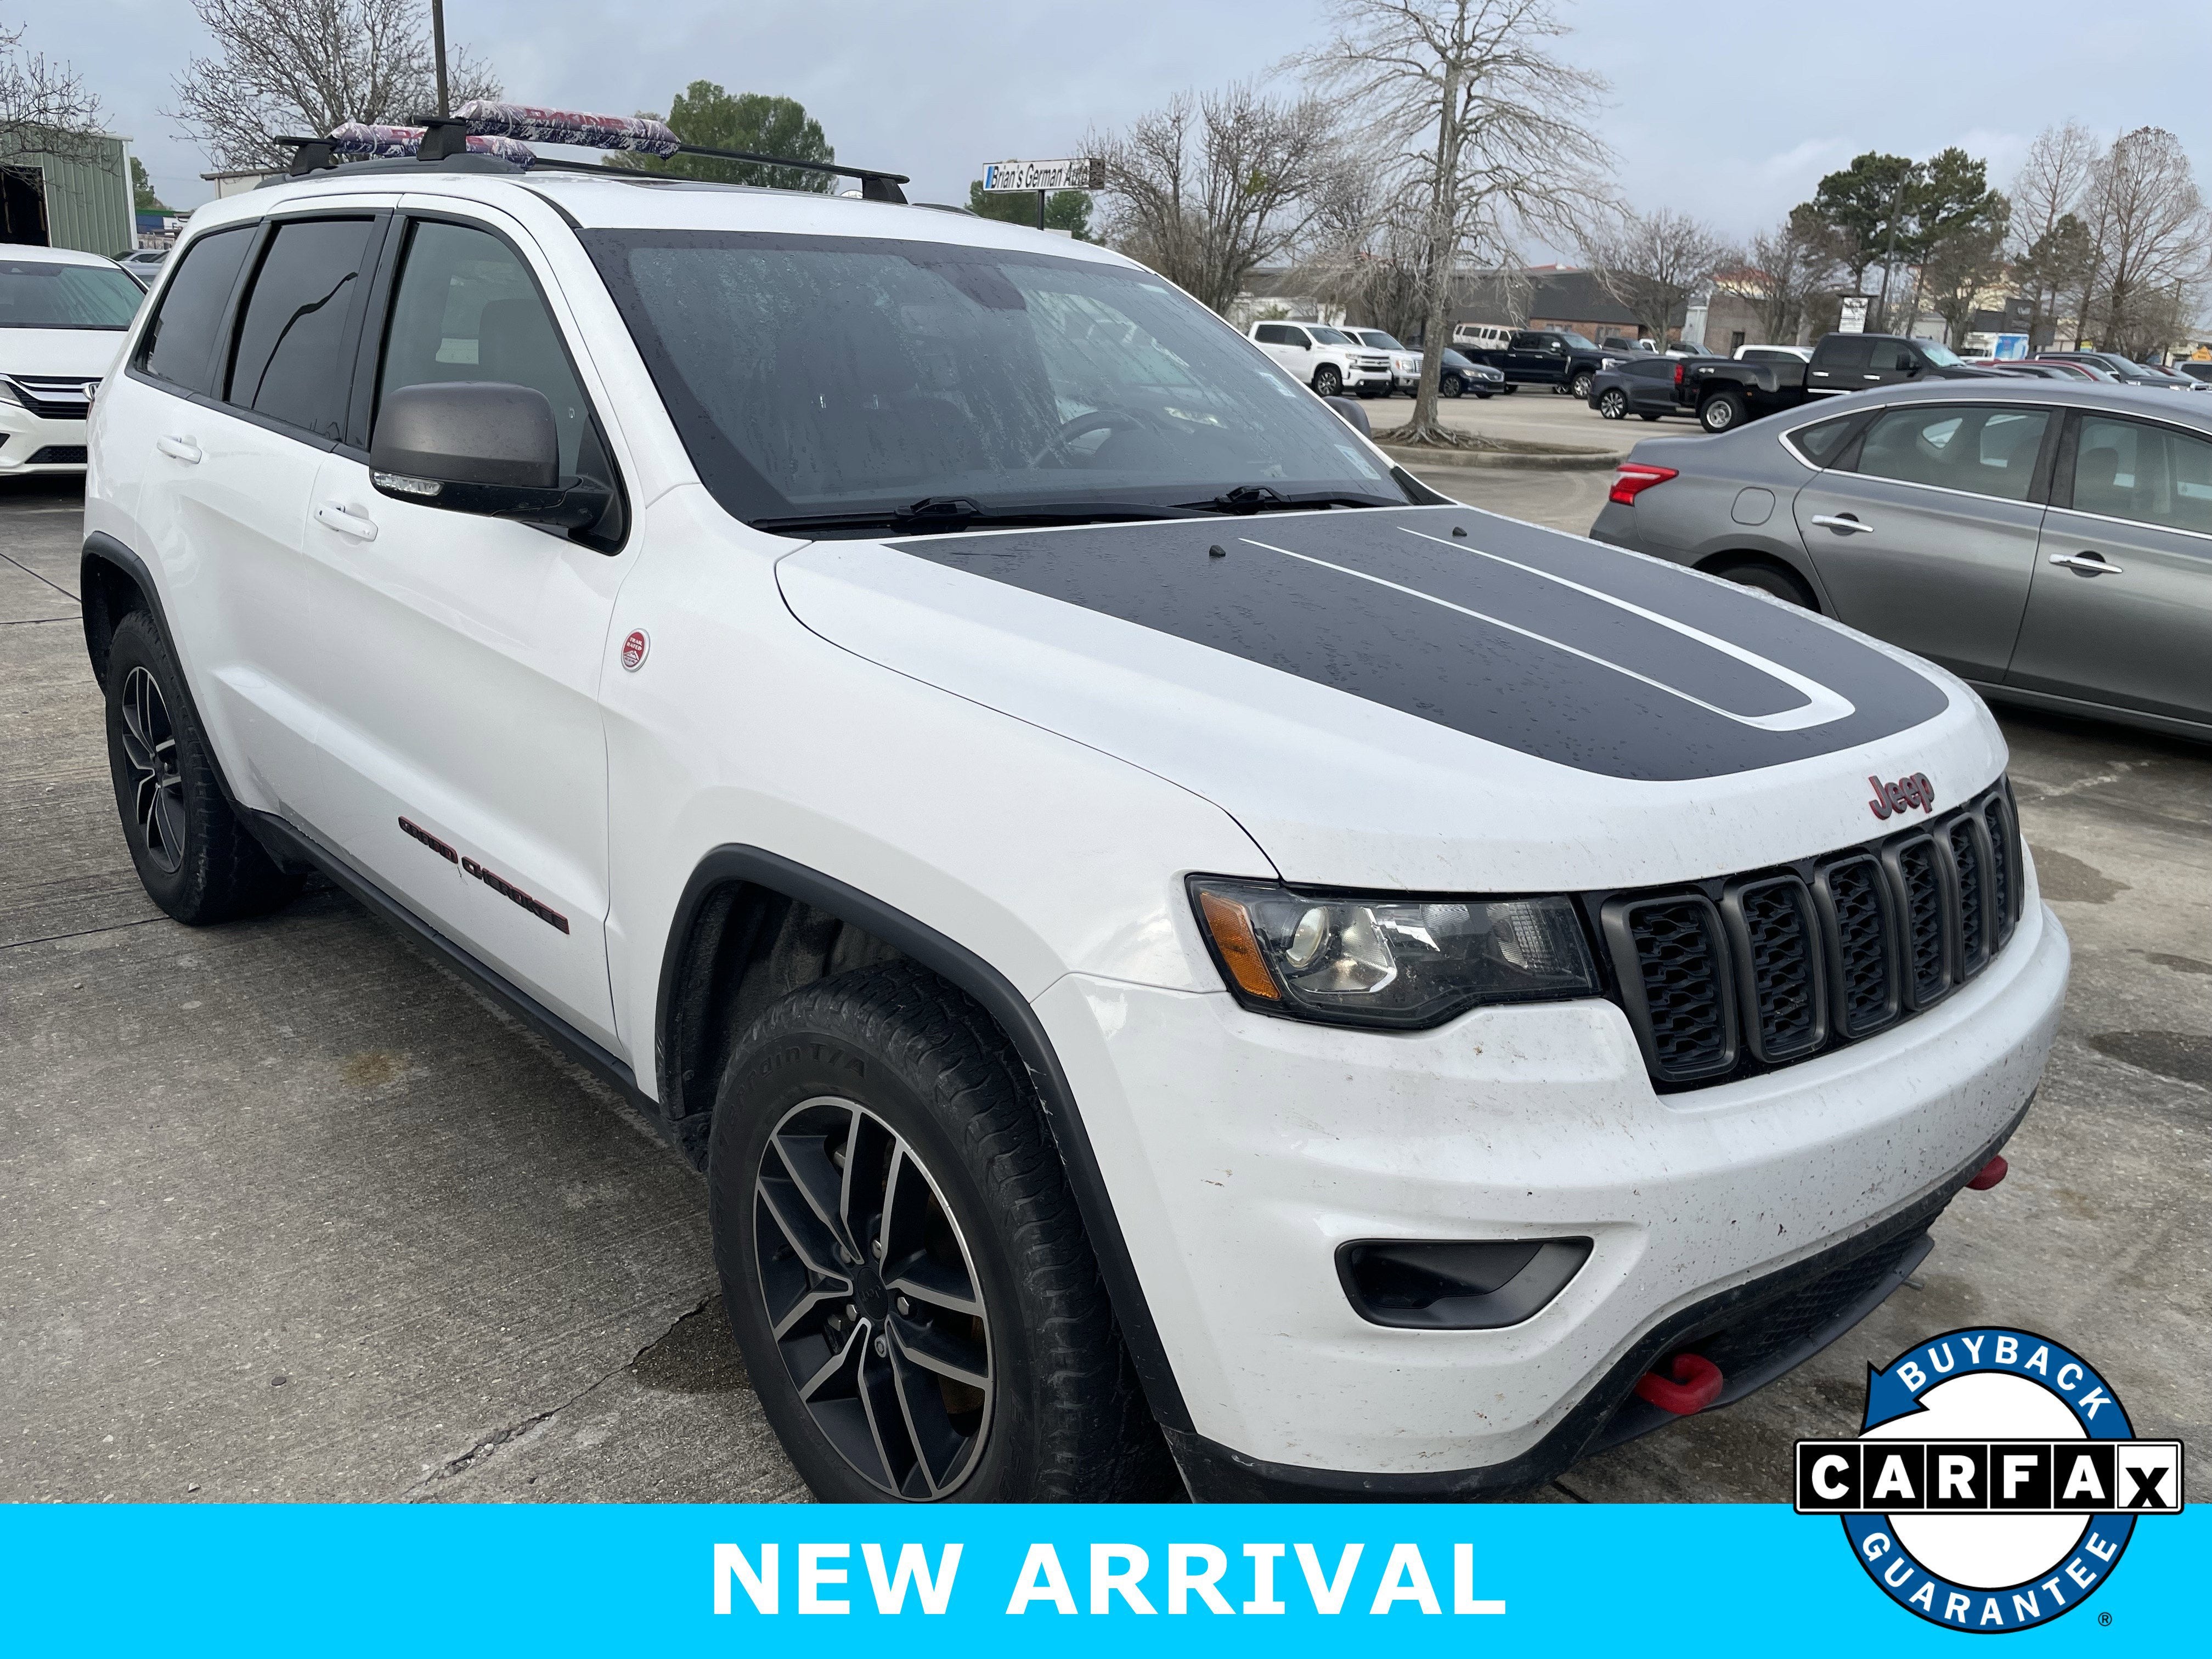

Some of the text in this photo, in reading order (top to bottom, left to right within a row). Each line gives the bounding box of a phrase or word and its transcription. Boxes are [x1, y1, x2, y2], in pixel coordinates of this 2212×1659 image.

[991, 166, 1023, 188] Brian's
[1026, 163, 1062, 188] German
[627, 641, 642, 651] RATED
[629, 637, 642, 646] TRAIL
[1869, 772, 1935, 820] Jeep
[398, 816, 570, 935] GRAND CHEROKEE
